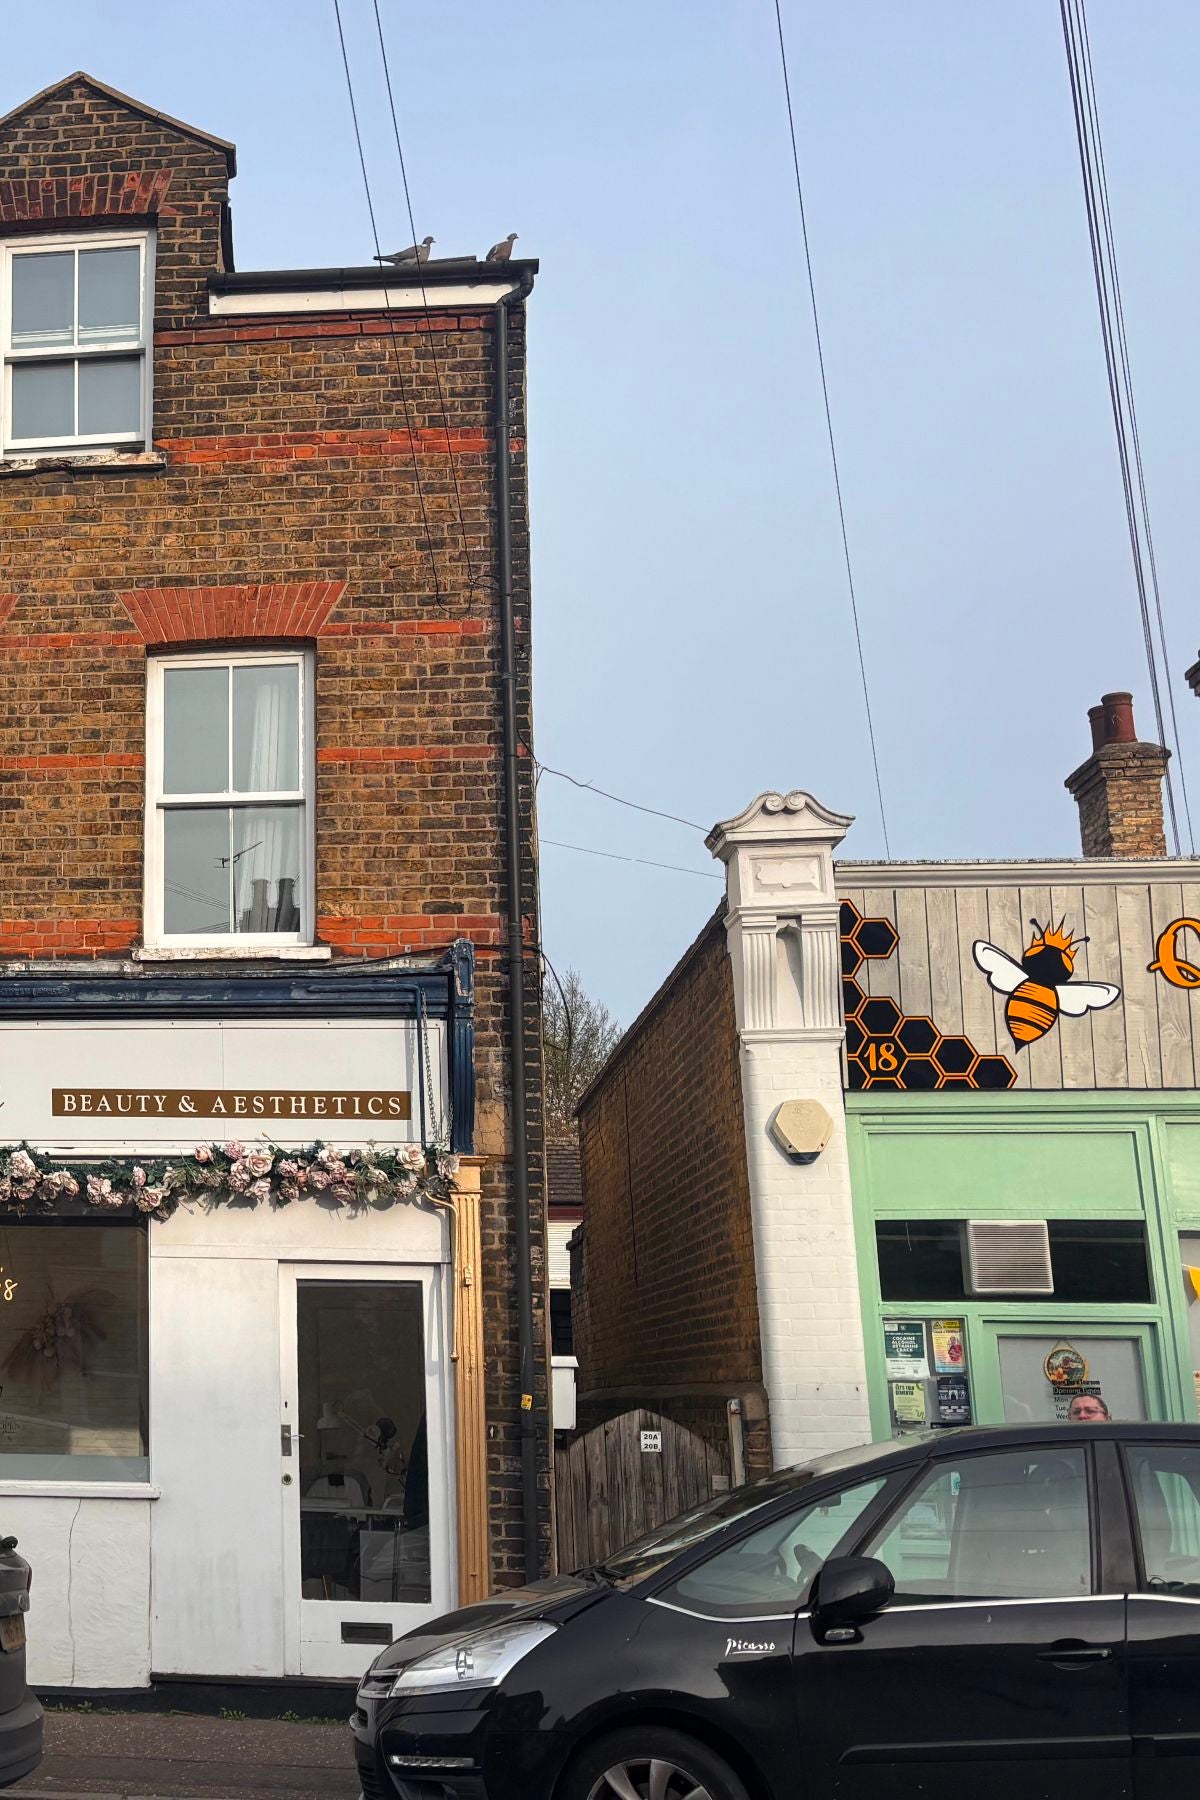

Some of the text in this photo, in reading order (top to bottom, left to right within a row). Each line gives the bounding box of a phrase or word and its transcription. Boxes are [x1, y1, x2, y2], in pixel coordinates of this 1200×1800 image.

[864, 1043, 898, 1071] 18
[63, 1094, 401, 1115] BEAUTY & AESTHETICS
[643, 1433, 658, 1441] 20A
[725, 1638, 776, 1656] Picasso
